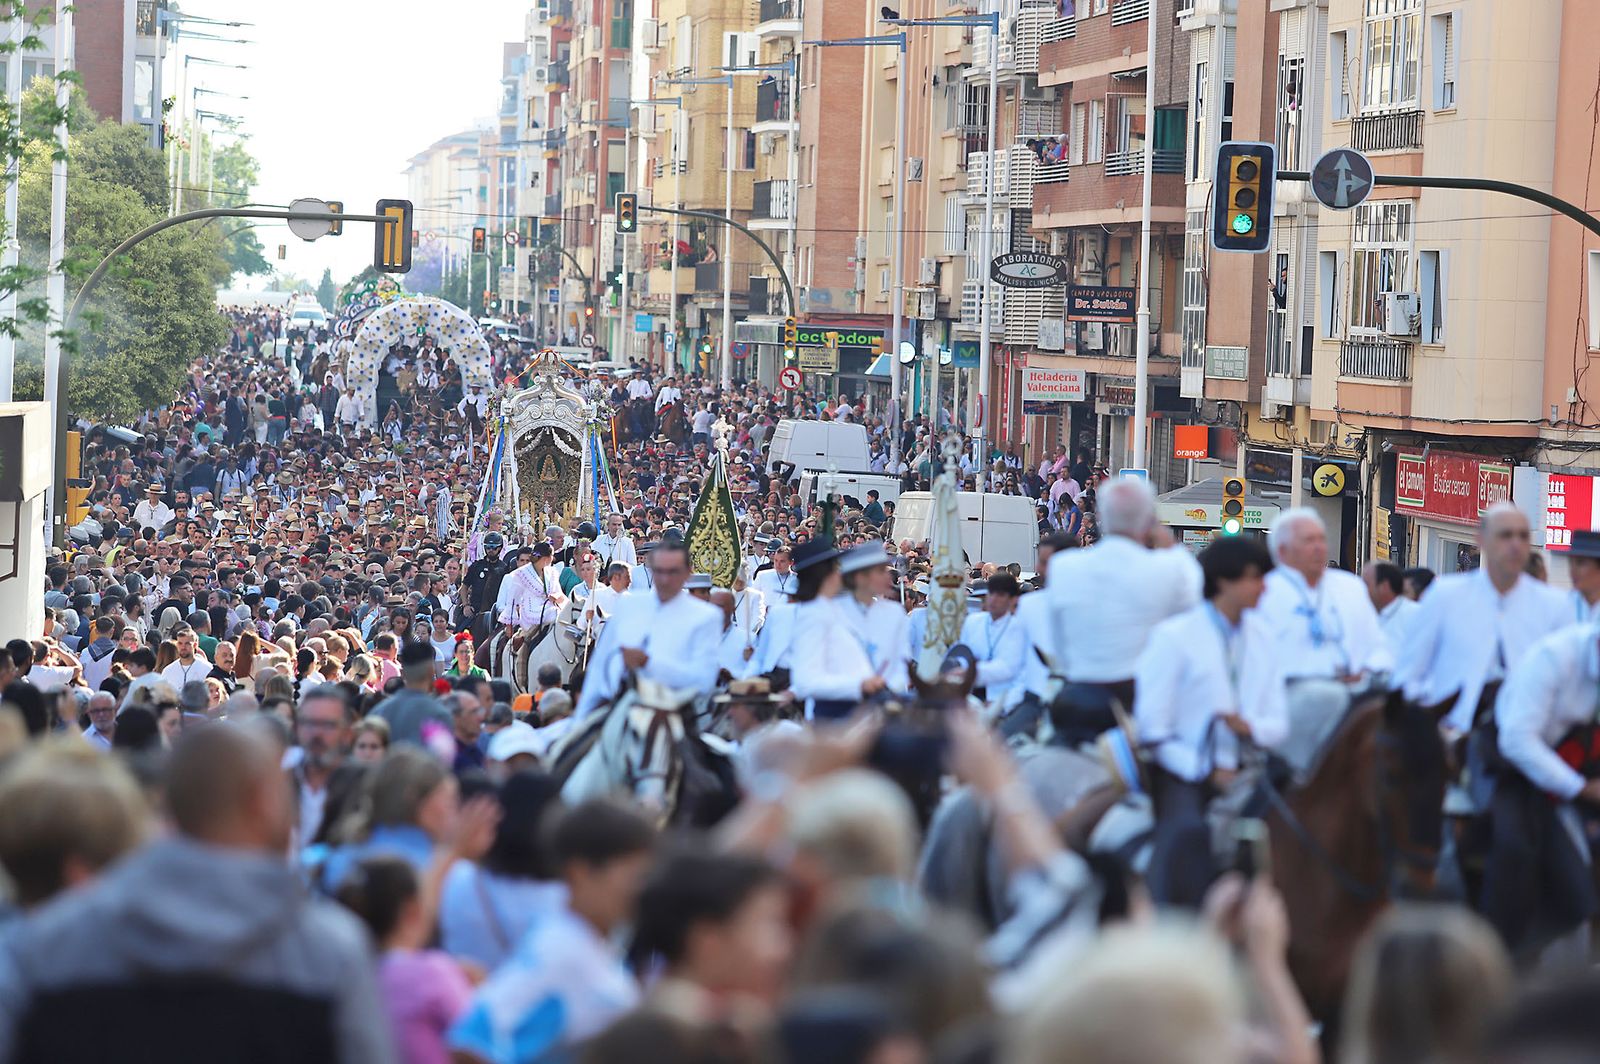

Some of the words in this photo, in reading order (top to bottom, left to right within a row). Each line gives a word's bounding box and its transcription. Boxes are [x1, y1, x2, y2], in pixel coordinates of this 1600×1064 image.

[994, 254, 1062, 269] LABORATORIO
[1075, 298, 1091, 309] Dr.
[795, 330, 881, 345] lectodom
[1027, 383, 1080, 392] Valenciana
[1176, 449, 1204, 458] orange
[1400, 463, 1405, 489] el
[1451, 480, 1470, 497] cercano
